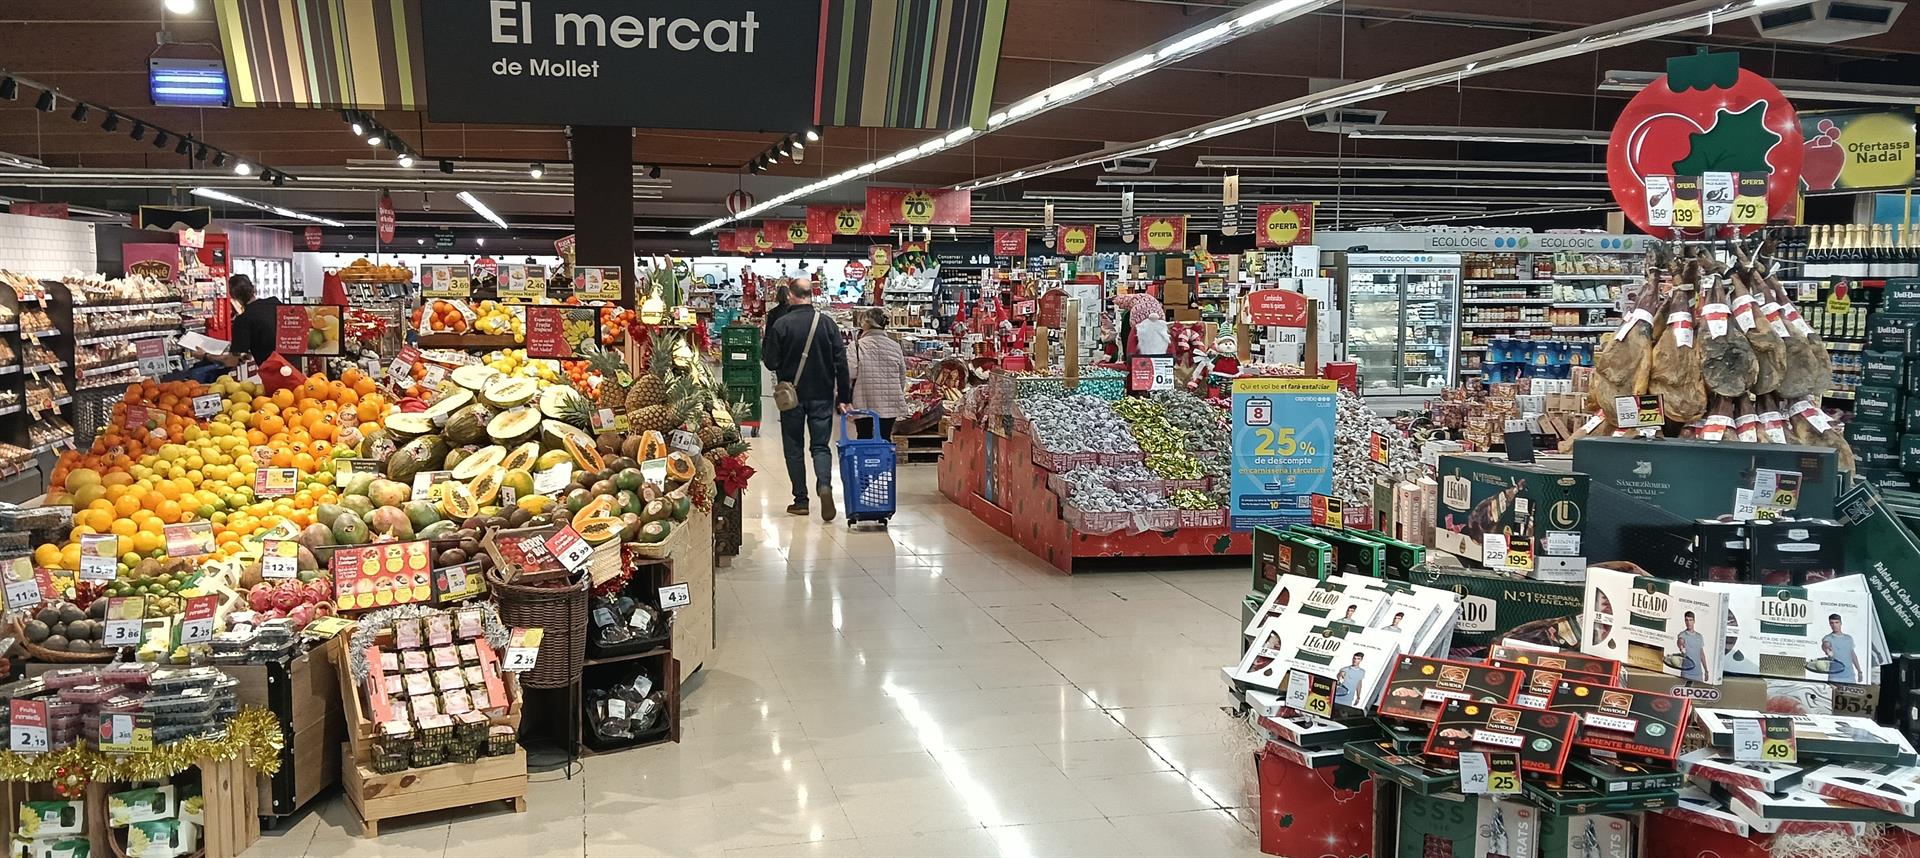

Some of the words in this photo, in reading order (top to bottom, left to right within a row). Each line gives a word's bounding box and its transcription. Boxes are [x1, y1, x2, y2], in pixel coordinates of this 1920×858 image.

[490, 0, 532, 44] El
[555, 11, 760, 53] mercat
[492, 58, 523, 76] de
[530, 59, 600, 78] Mollet
[1848, 140, 1910, 153] Ofertassa
[1856, 151, 1902, 164] Nadal
[904, 201, 932, 215] 70%
[1736, 204, 1756, 218] 79
[1673, 209, 1693, 222] 139
[1269, 222, 1298, 230] OFERTA
[1294, 265, 1313, 277] Lan
[1280, 331, 1296, 343] Lan
[1253, 407, 1264, 419] 8
[1640, 413, 1659, 422] 227
[1254, 457, 1266, 465] de
[1267, 457, 1313, 466] descompte
[1446, 480, 1468, 502] LEGADO
[1269, 501, 1279, 509] 10
[1776, 494, 1793, 505] 49
[1486, 550, 1503, 560] 225
[1508, 555, 1528, 566] 195
[1873, 561, 1893, 582] Paleta
[1889, 579, 1901, 591] de
[1896, 586, 1912, 606] Cebo
[668, 591, 688, 602] 4,29
[1307, 589, 1340, 605] LEGADO
[1869, 575, 1883, 591] 50%
[1880, 588, 1898, 608] Raza
[1631, 592, 1668, 613] LEGADO
[1460, 601, 1488, 623] ADO
[1761, 600, 1807, 618] LEGADO
[115, 627, 139, 639] 3,86
[190, 626, 210, 638] 2,25
[1302, 635, 1341, 652] LEGADO
[513, 654, 535, 665] 2,25
[1313, 682, 1330, 692] OFERTA
[1309, 698, 1327, 712] 49
[14, 713, 41, 722] vermella
[1592, 719, 1628, 729] RESERVA
[21, 732, 46, 747] 2,19
[1480, 736, 1515, 745] RESERVA
[1744, 740, 1759, 751] 55
[1767, 743, 1789, 757] 49
[1470, 773, 1485, 783] 42
[1493, 776, 1515, 790] 25
